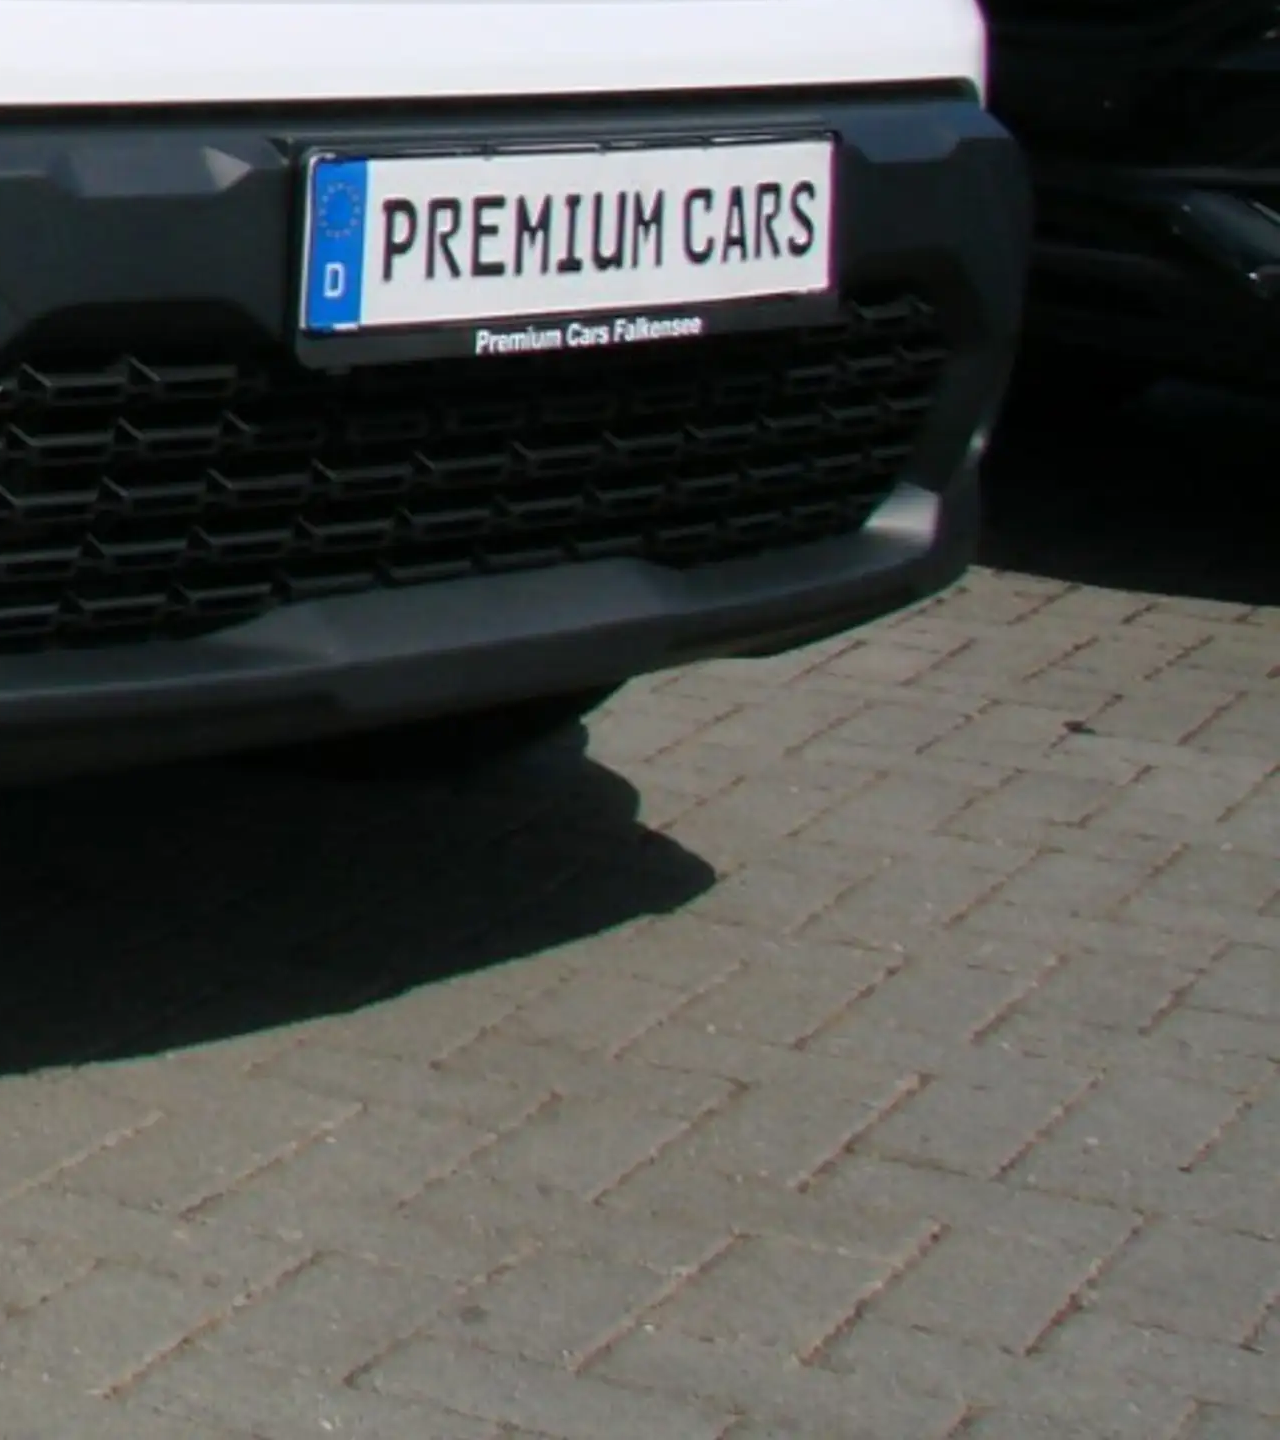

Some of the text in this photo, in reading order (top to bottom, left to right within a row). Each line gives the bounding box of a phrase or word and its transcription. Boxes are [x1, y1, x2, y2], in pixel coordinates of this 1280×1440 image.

[381, 181, 816, 283] PREMIUM CARS
[322, 263, 345, 298] D
[474, 316, 703, 356] Premium Cars Falkensee
